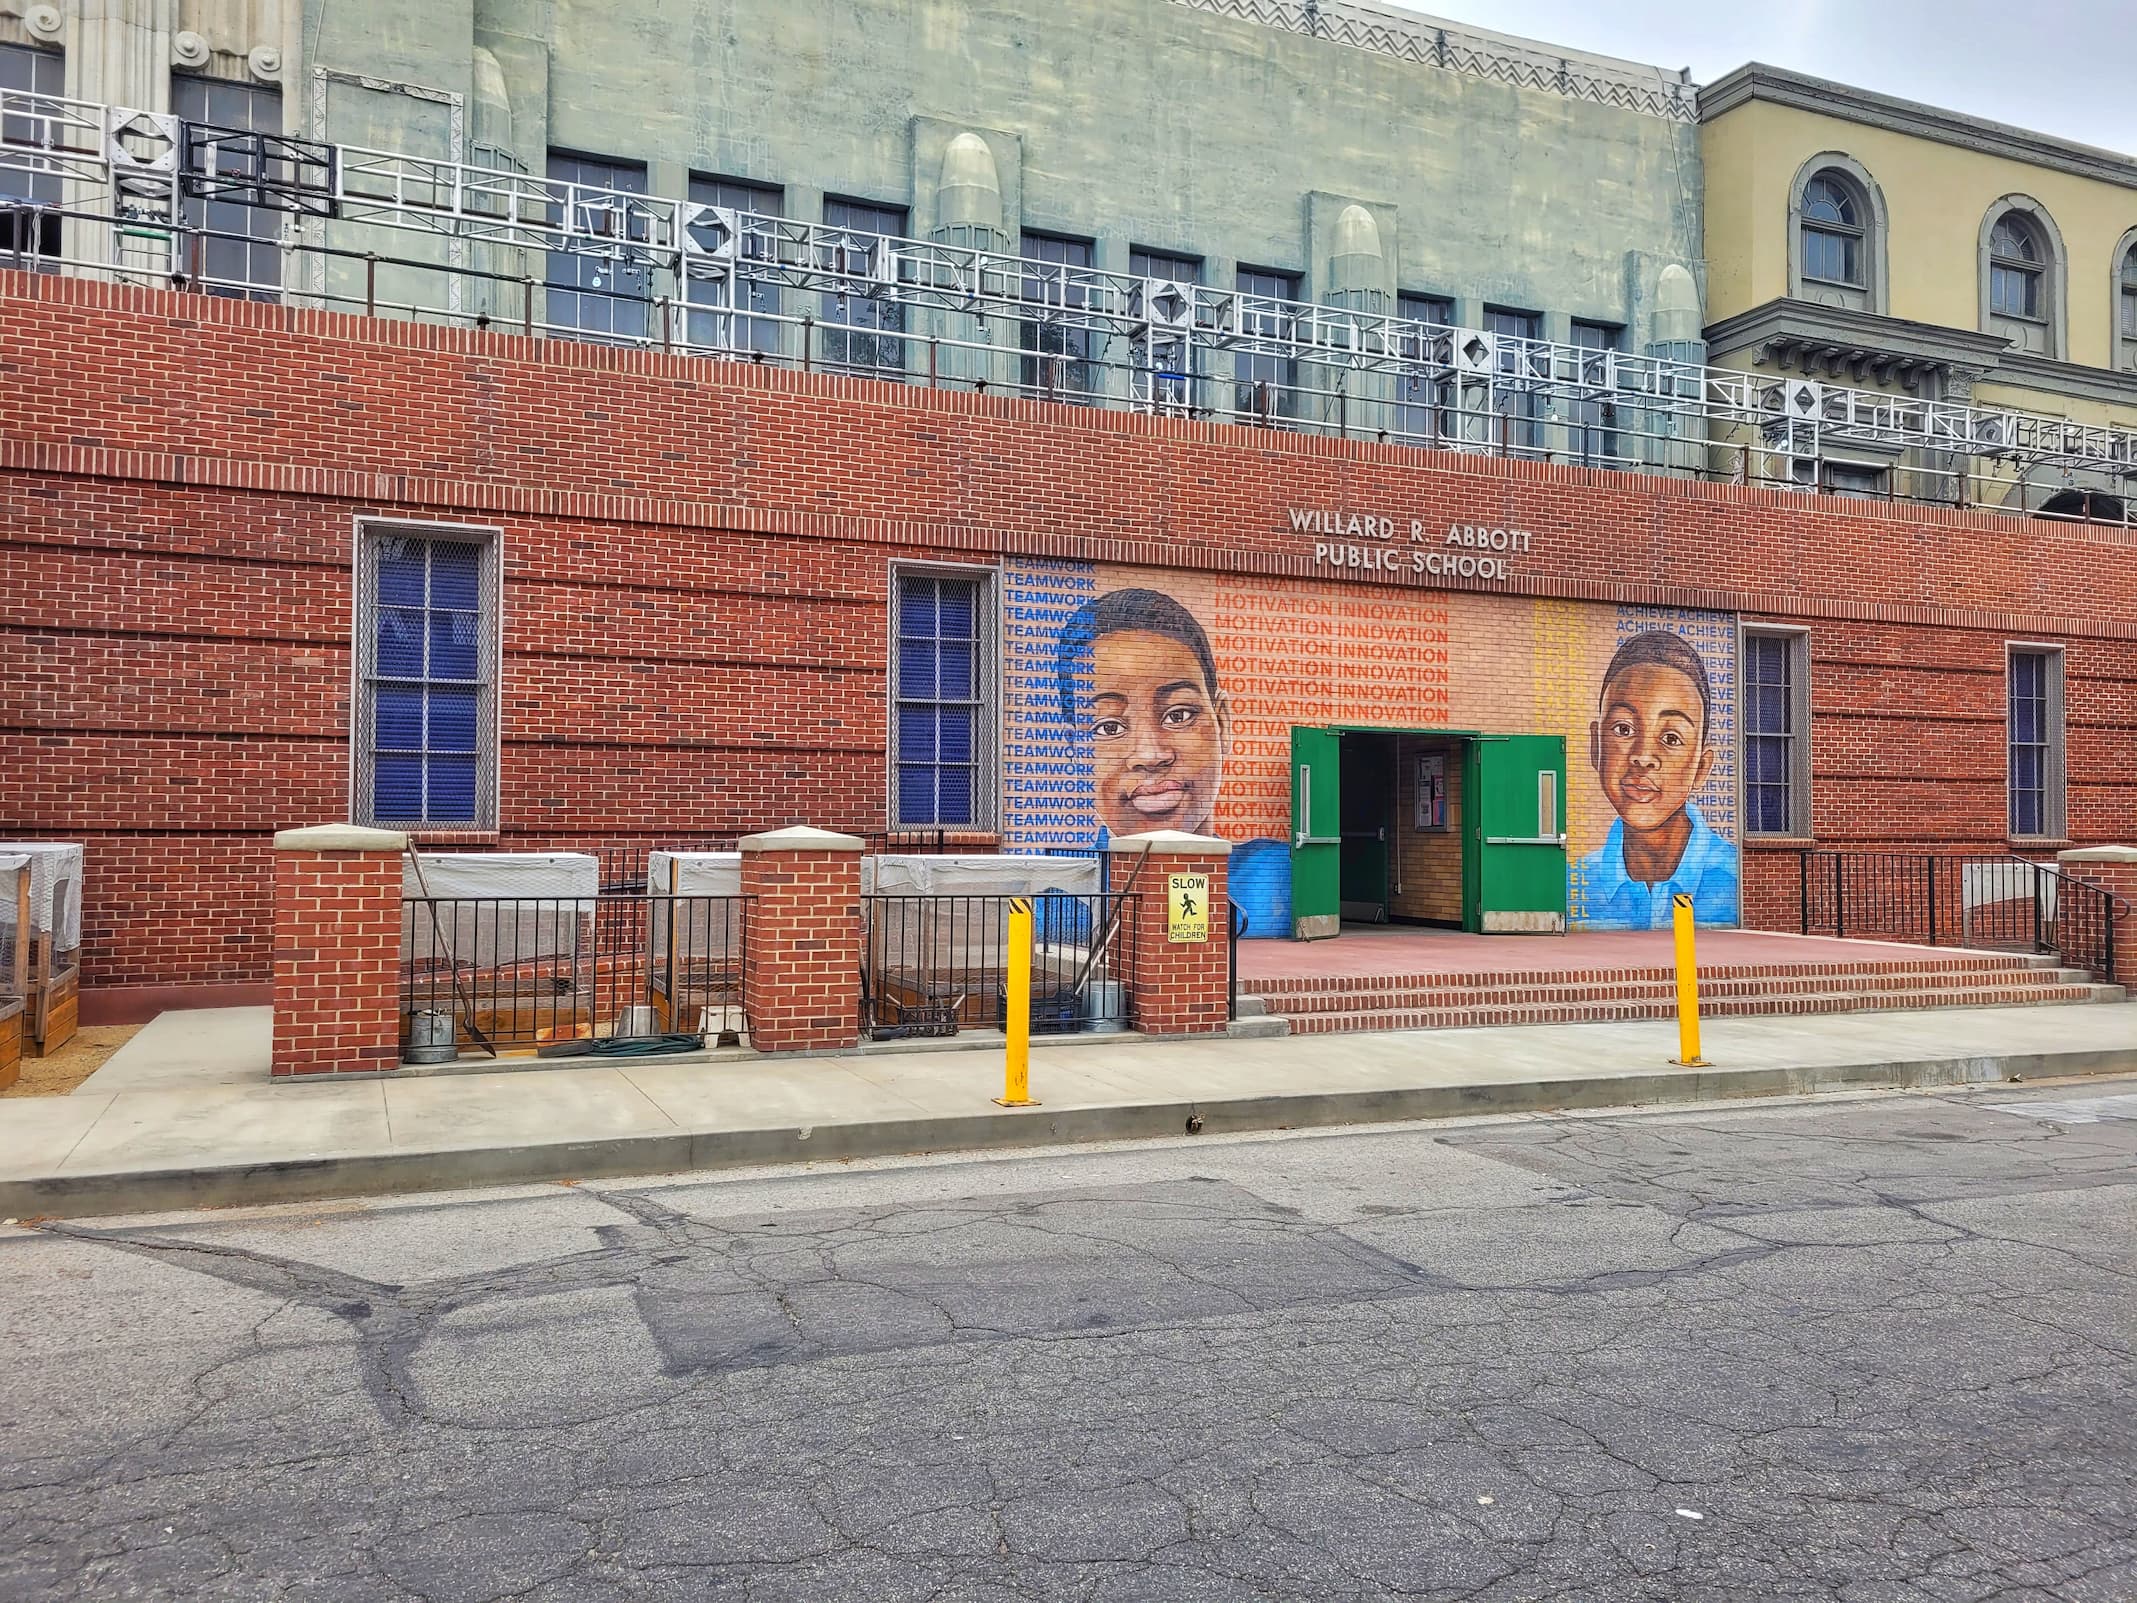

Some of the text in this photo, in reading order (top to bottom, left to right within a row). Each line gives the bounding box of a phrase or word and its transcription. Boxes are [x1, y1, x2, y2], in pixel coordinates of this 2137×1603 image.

[1288, 508, 1532, 553] WILLARD R. ABBOTT
[1004, 557, 1096, 574] TEAMWORK
[1315, 543, 1507, 581] PUBLIC SCHOOL
[1004, 573, 1096, 591] TEAMWORK
[1004, 589, 1096, 605] TEAMWORK
[1215, 592, 1448, 625] MOTIVATION INNOVATION
[1616, 606, 1735, 623] ACHIEVE ACHIEVE
[1215, 613, 1448, 643] MOTIVATION INNOVATION
[1678, 624, 1735, 639] ACHIEVE
[1004, 641, 1096, 658] TEAMWORK
[1215, 634, 1448, 664] MOTIVATION INNOVATION
[1004, 659, 1096, 674] TEAMWORK
[1215, 655, 1448, 683] MOTIVATION INNOVATION
[1004, 676, 1096, 692] TEAMWORK
[1004, 693, 1096, 709] TEAMWORK
[1337, 683, 1448, 704] INNOVATION
[1231, 698, 1448, 723] OTIVATION INNOVATION
[1004, 727, 1096, 742] TEAMWORK
[1004, 745, 1096, 758] TEAMWORK
[1004, 762, 1096, 775] TEAMWORK
[1222, 760, 1291, 777] MOTIVA
[1004, 779, 1096, 792] TEAMWORK
[1219, 781, 1291, 798] MOTIVA
[1004, 796, 1096, 809] TEAMWORK
[1215, 802, 1291, 819] MOTIVA
[1004, 814, 1096, 826] TEAMWORK
[1004, 831, 1096, 842] TEAMWORK
[1215, 823, 1291, 840] MOTIVA
[1172, 878, 1206, 889] SLOW
[1170, 931, 1206, 939] CHILDREN
[1172, 923, 1190, 931] WATCH
